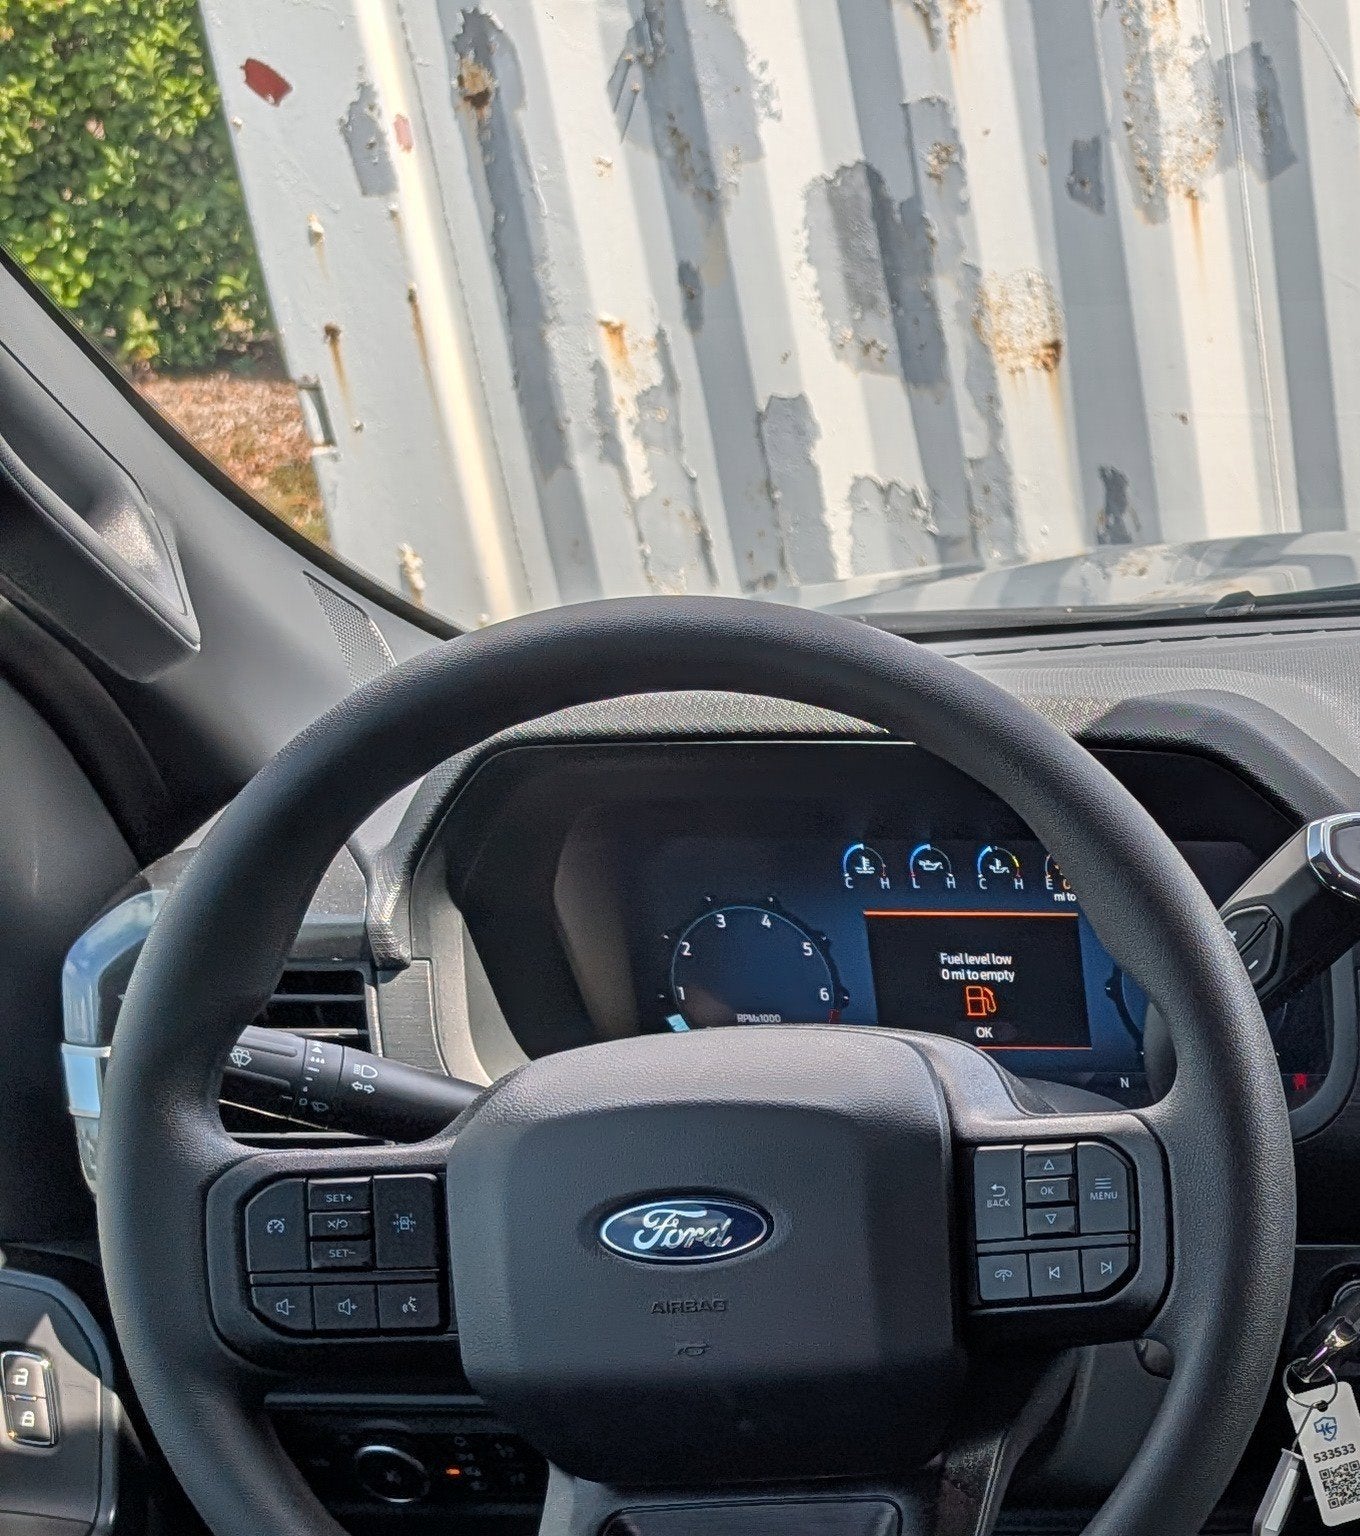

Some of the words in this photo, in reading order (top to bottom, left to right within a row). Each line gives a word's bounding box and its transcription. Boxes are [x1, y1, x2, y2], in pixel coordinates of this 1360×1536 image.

[845, 877, 854, 889] C
[880, 878, 891, 890] H
[912, 878, 920, 889] L
[946, 878, 956, 889] H
[979, 878, 988, 890] C
[1014, 878, 1024, 890] H
[1045, 879, 1053, 890] E
[1054, 893, 1065, 902] mi
[715, 914, 726, 928] 3
[761, 914, 772, 928] 4
[681, 942, 692, 956] 2
[802, 942, 813, 956] 5
[940, 953, 964, 965] Fuel
[965, 953, 992, 965] level
[993, 953, 1012, 965] low
[941, 969, 949, 980] 0
[952, 969, 965, 980] mi
[967, 969, 979, 980] to
[980, 970, 1015, 982] empty
[677, 986, 686, 1001] 1
[819, 987, 830, 1001] 6
[976, 1027, 994, 1038] OK
[1121, 1078, 1130, 1088] N
[1040, 1187, 1054, 1195] OK
[1090, 1192, 1118, 1201] MENU
[987, 1200, 1011, 1208] BACK
[633, 1208, 733, 1250] Ford
[651, 1299, 727, 1315] AIRBAG
[1314, 1444, 1356, 1463] 533533
